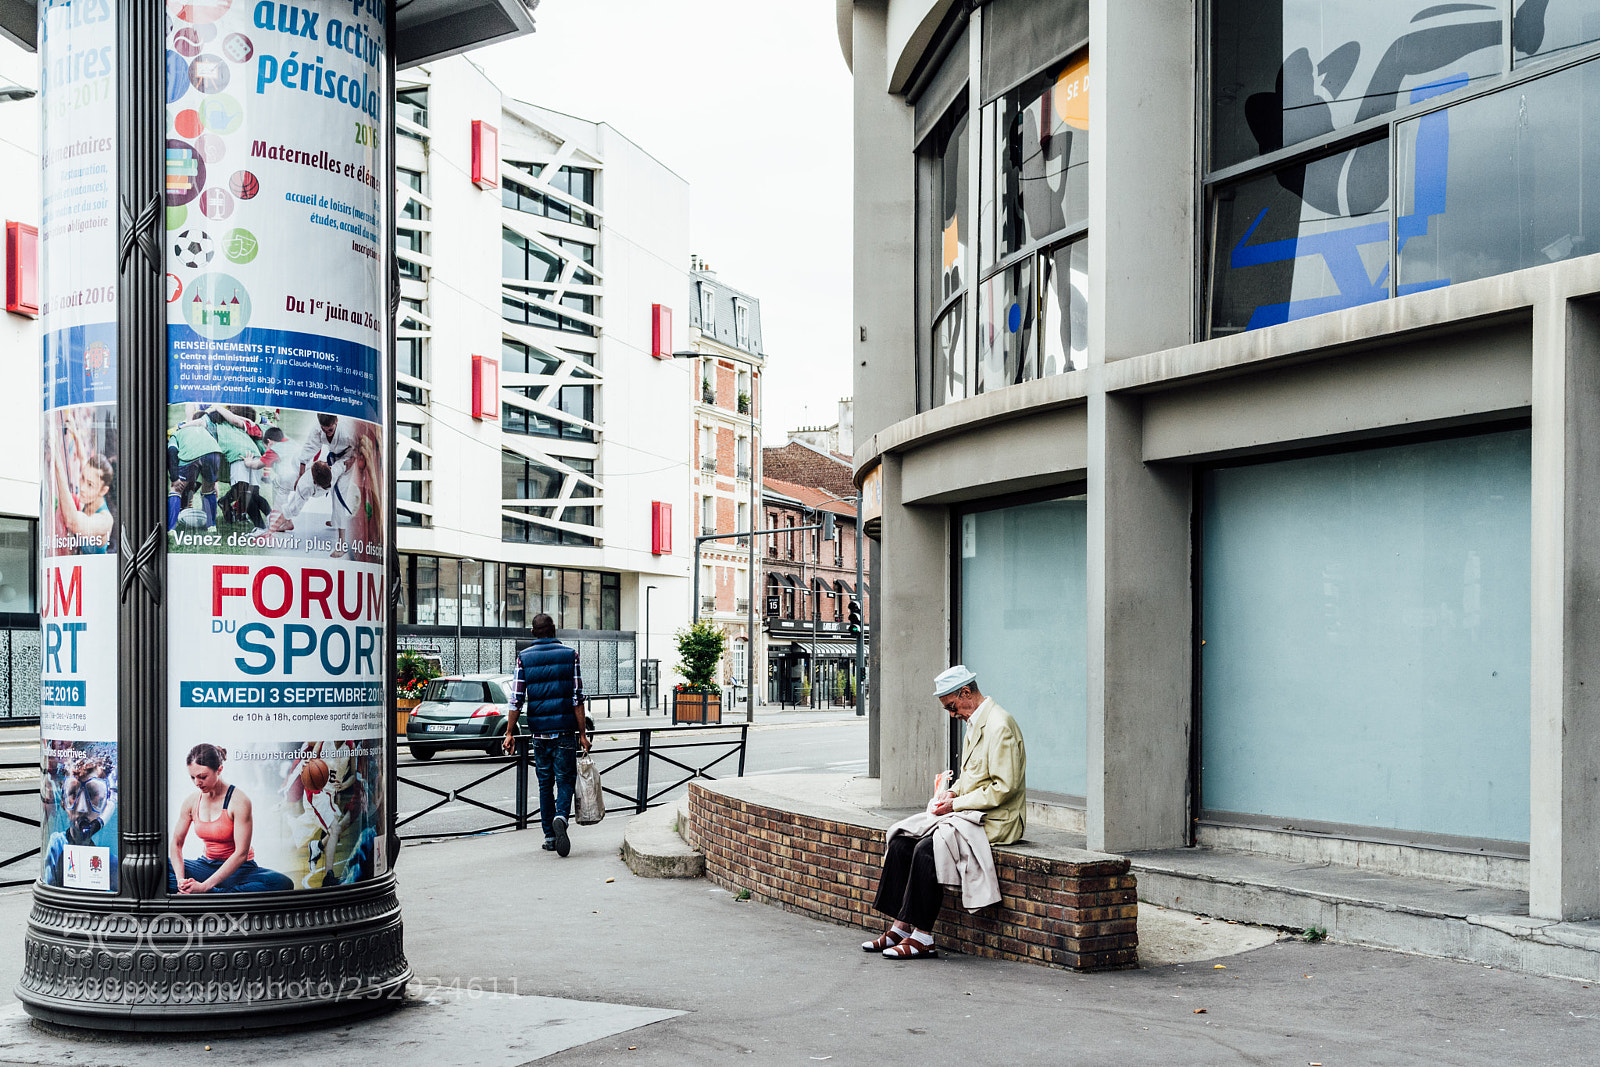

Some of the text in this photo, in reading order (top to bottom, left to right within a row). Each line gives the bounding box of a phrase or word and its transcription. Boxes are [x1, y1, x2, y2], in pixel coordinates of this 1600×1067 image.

[253, 0, 320, 41] aux
[1066, 80, 1079, 101] SE
[250, 139, 341, 174] Maternelles
[344, 162, 355, 179] et
[285, 191, 317, 206] accueil
[318, 195, 329, 209] de
[329, 197, 352, 216] loisirs
[310, 211, 339, 230] études,
[339, 219, 362, 237] accueil
[85, 285, 115, 305] 2016
[286, 295, 305, 314] Du
[325, 301, 349, 322] juin
[350, 310, 364, 326] au
[364, 310, 373, 329] 26
[173, 340, 263, 353] RENSEIGNEMENTS
[265, 345, 276, 354] ET
[180, 352, 207, 360] Centre
[207, 353, 259, 363] administratif
[288, 358, 332, 371] Claude-Monet
[180, 362, 212, 371] Horaires
[213, 363, 258, 373] d'ouverture
[180, 372, 190, 381] du
[191, 372, 211, 381] lundi
[223, 374, 256, 383] vendredi
[257, 376, 275, 385] 8h30
[283, 378, 296, 386] 12h
[305, 380, 323, 390] 13h30
[330, 384, 340, 392] 17h
[180, 383, 252, 393] www.saint-ouen.fr
[256, 386, 288, 397] rubrique
[309, 390, 341, 402] démarches
[52, 531, 103, 551] isciplines
[172, 529, 222, 547] Venez
[227, 530, 301, 550] découvrir
[305, 535, 331, 553] plus
[334, 539, 349, 553] de
[351, 539, 364, 554] 40
[212, 564, 384, 623] FORUM
[769, 601, 778, 610] 15
[211, 619, 384, 676] DU SPORT
[55, 686, 80, 702] 2016
[191, 687, 265, 704] SAMEDI
[269, 687, 280, 704] 3
[283, 687, 367, 704] SEPTEMBRE
[232, 712, 244, 722] de
[247, 712, 263, 722] 10h
[265, 711, 271, 721] à
[273, 711, 291, 723] 18h,
[291, 713, 329, 723] complexe
[329, 711, 351, 722] sportif
[341, 722, 368, 732] Boulevard
[57, 747, 87, 760] sportives
[233, 747, 318, 761] Démonstrations
[319, 748, 330, 760] et
[330, 746, 369, 760] animations
